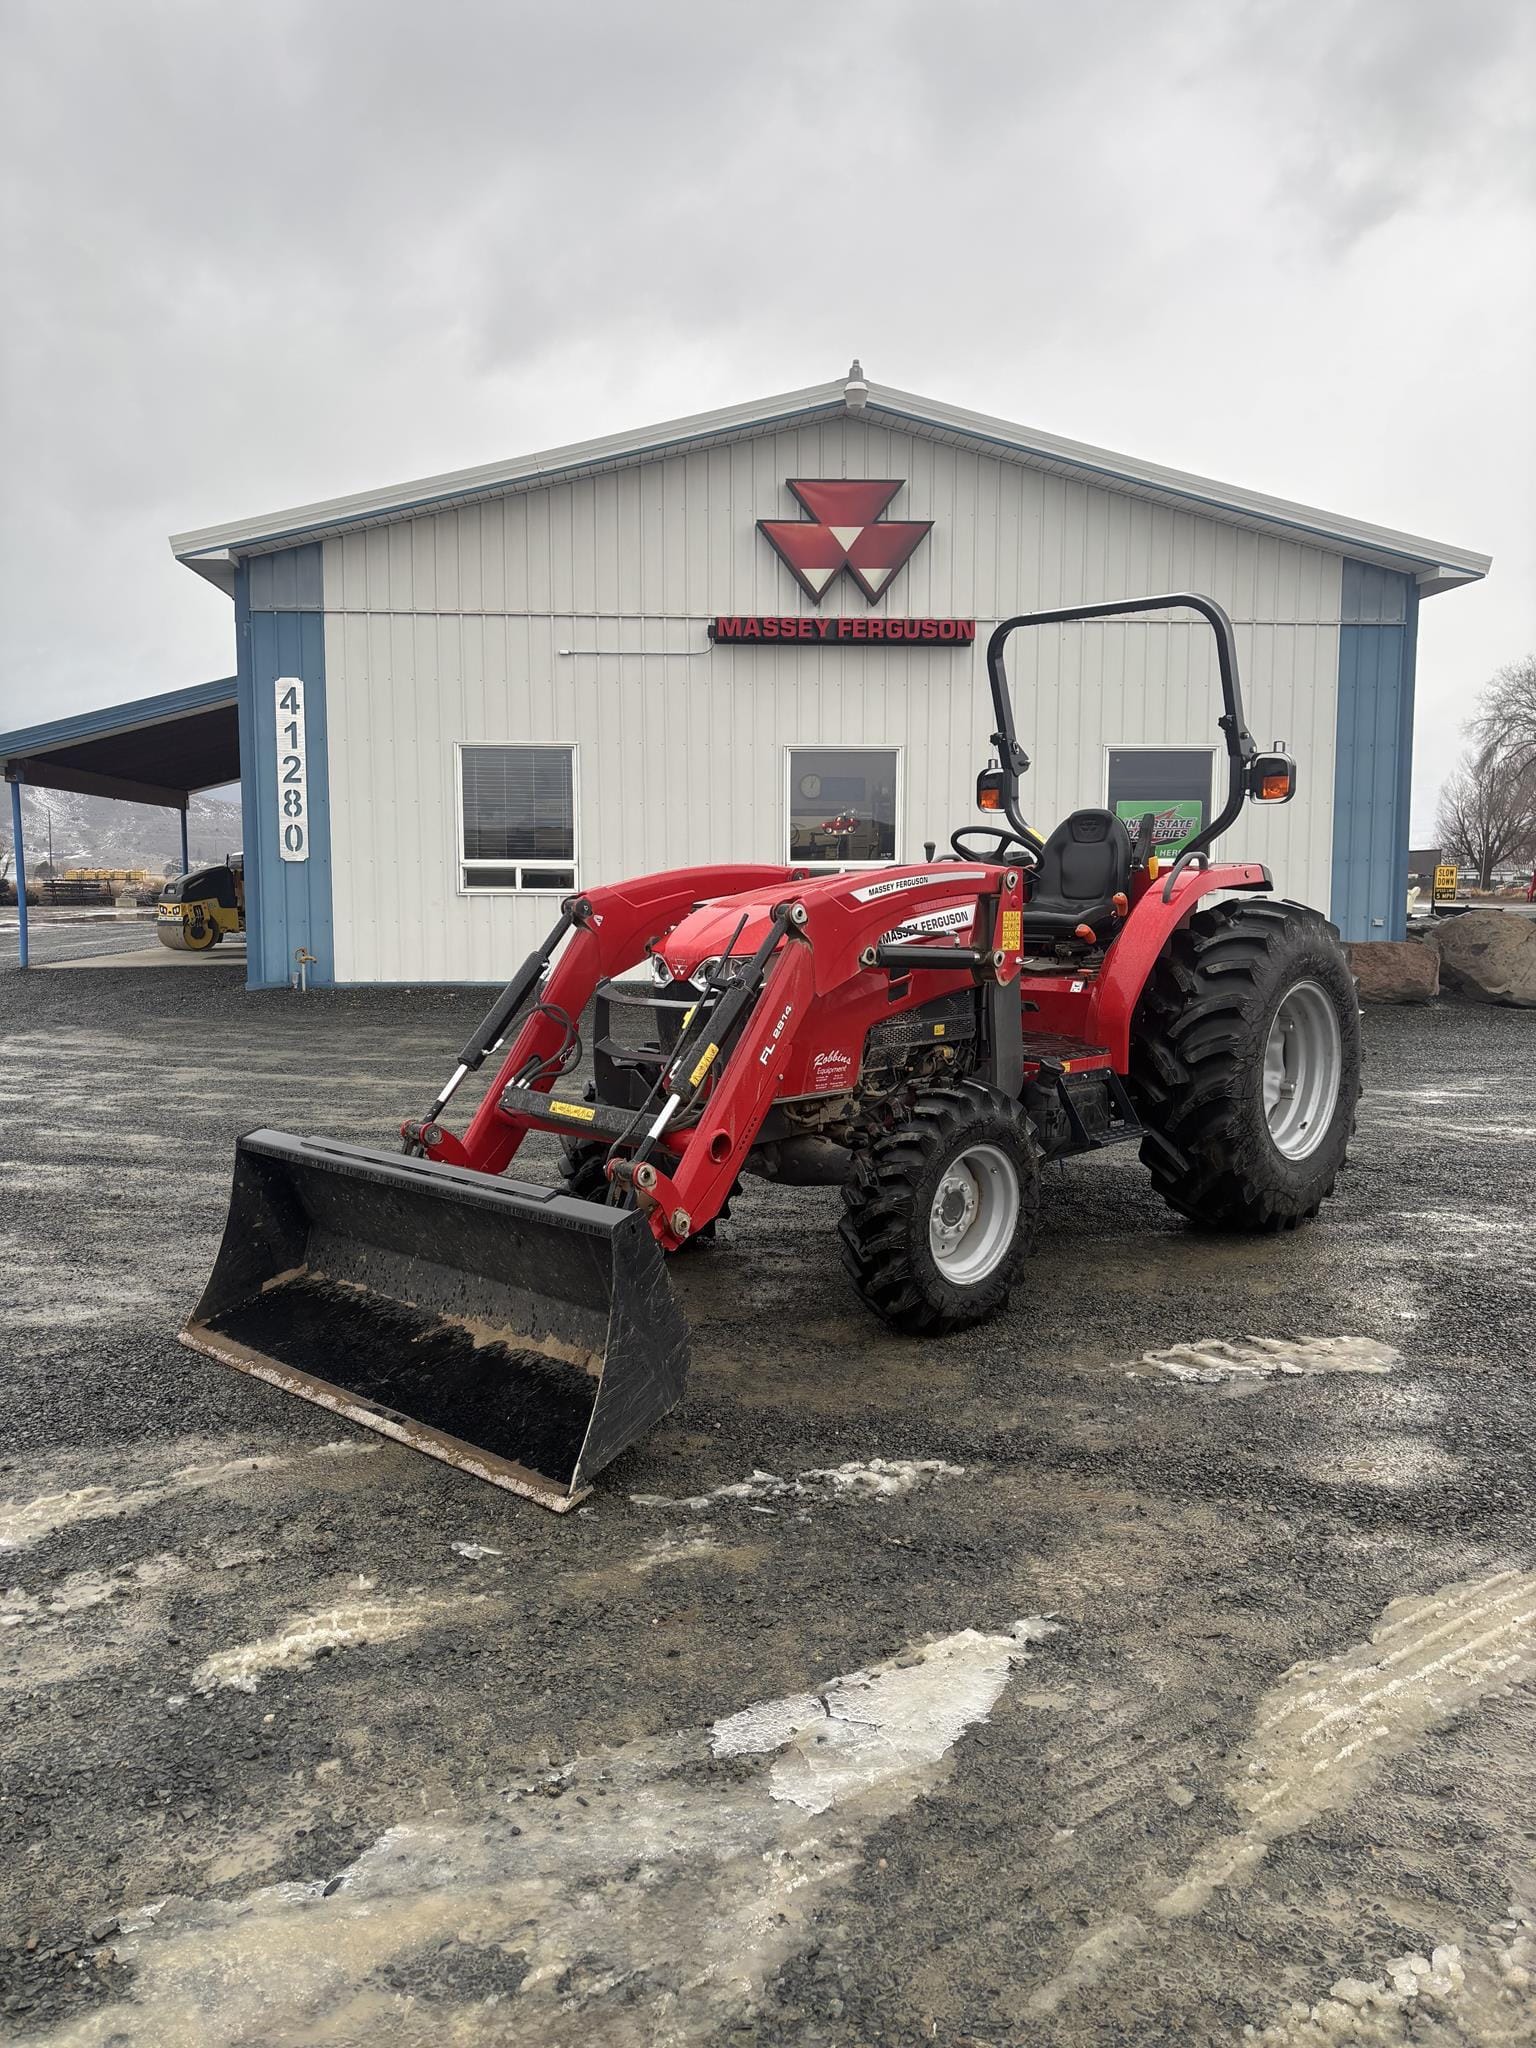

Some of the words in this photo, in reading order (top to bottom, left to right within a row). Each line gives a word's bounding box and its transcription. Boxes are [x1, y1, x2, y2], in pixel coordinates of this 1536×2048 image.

[717, 617, 830, 637] MASSEY
[838, 619, 975, 640] FERGUSON
[279, 687, 304, 852] 41280
[1125, 819, 1193, 828] INTRSTATE
[1129, 830, 1187, 838] BAERIES
[1438, 869, 1454, 877] SLOW
[1438, 878, 1454, 886] DOWN
[868, 884, 894, 896] MASSEY
[896, 876, 928, 888] FERGUSON
[921, 911, 968, 931] FERGUSON
[759, 1044, 776, 1065] FL
[813, 1050, 852, 1070] Robbins
[816, 1065, 848, 1076] Equipment
